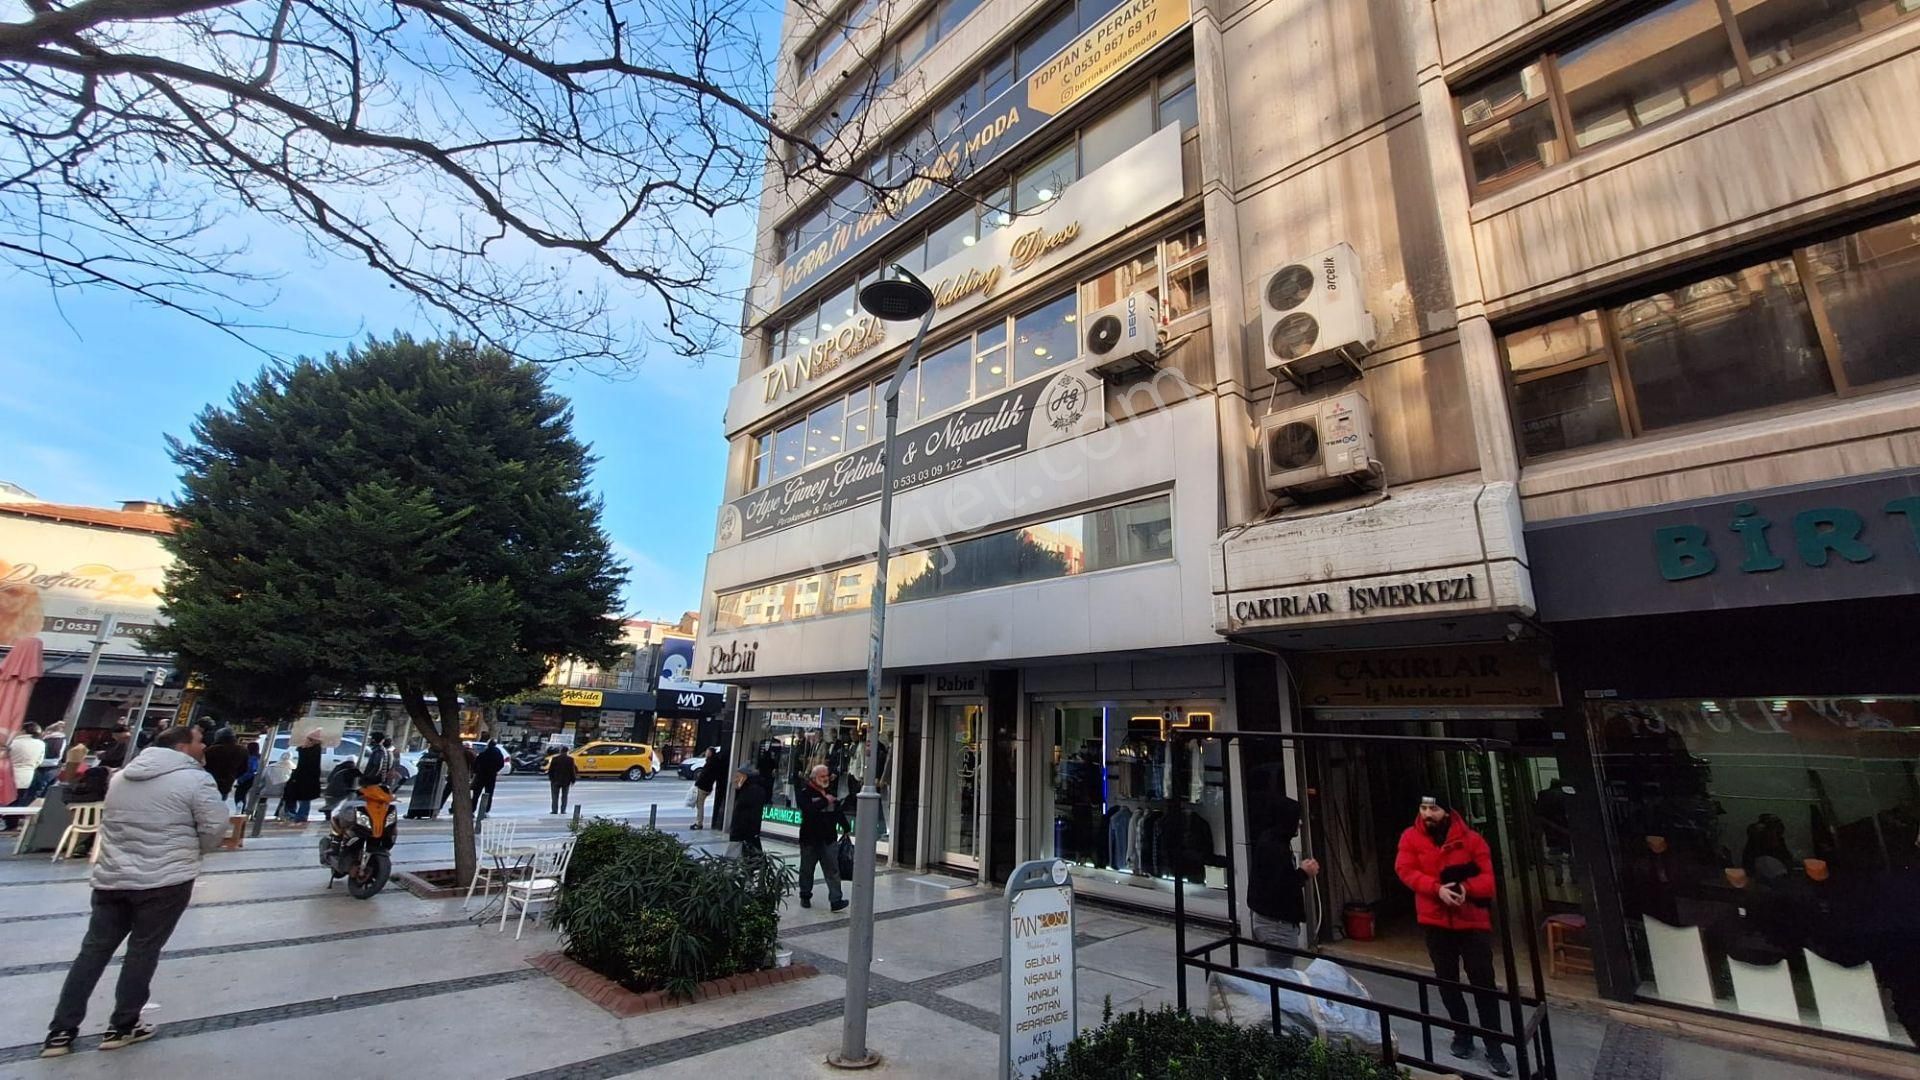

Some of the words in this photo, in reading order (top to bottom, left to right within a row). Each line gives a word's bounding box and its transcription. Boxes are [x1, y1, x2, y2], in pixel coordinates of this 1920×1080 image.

[1033, 48, 1080, 90] TOPTAN
[1084, 39, 1093, 53] &
[1097, 0, 1152, 43] PERAKE
[1074, 51, 1101, 76] 0530
[1104, 35, 1125, 57] 967
[1128, 21, 1142, 38] 69
[1145, 8, 1158, 25] 17
[965, 106, 1020, 158] MODA
[1010, 219, 1081, 270] Dress
[1323, 256, 1337, 291] arçelik
[1128, 297, 1137, 338] BEKO
[746, 490, 780, 524] Ayşe
[779, 477, 831, 515] Güney
[829, 448, 887, 498] Gelinli
[902, 442, 918, 465] &
[925, 394, 1026, 454] Nişanlık
[901, 473, 916, 487] 533
[918, 469, 929, 482] 03
[932, 466, 943, 477] 09
[946, 458, 963, 472] 122
[1235, 592, 1333, 625] ÇAKIRLAR
[1348, 573, 1478, 614] İŞMERKEZİ
[1335, 654, 1501, 688] ÇAKIRLAR
[677, 692, 705, 707] MAD
[1387, 684, 1471, 700] Merkezi
[1024, 952, 1061, 969] GELİNLİK
[1024, 970, 1062, 987] NİŞANLIK
[1027, 986, 1059, 1002] KINALIK
[1016, 1011, 1068, 1033] PERAKENDE
[1026, 1000, 1061, 1016] TOPTAN
